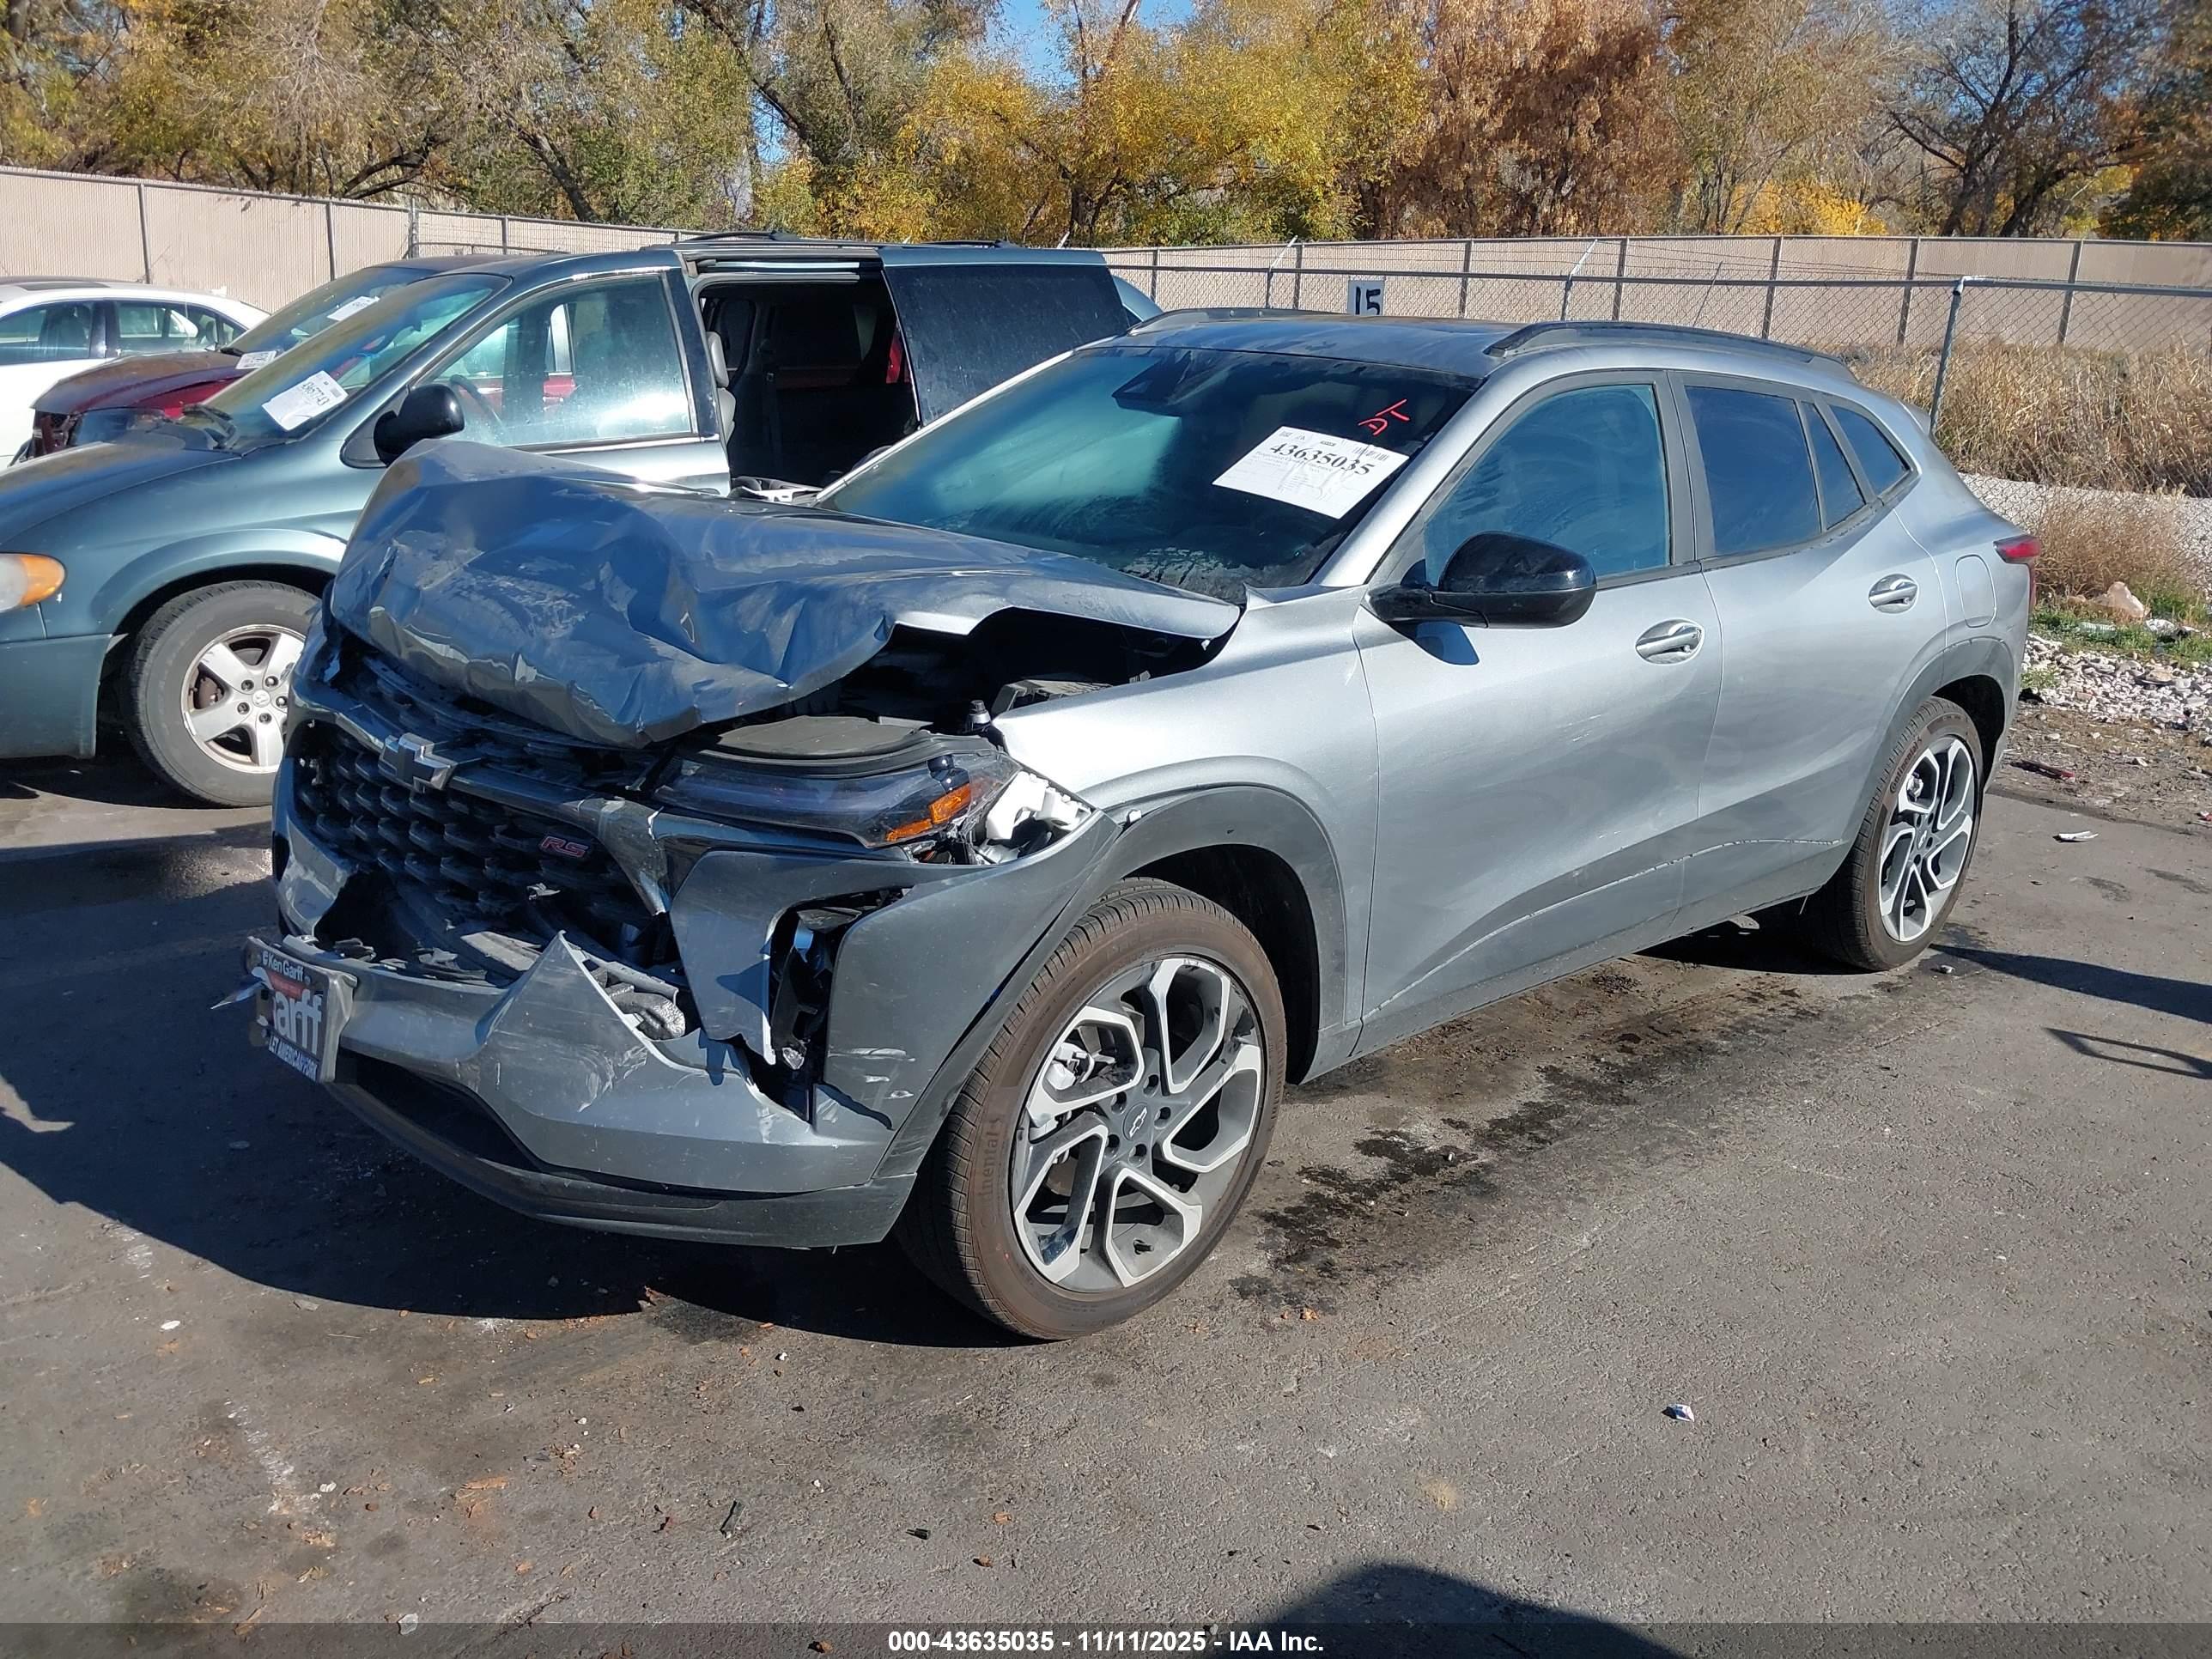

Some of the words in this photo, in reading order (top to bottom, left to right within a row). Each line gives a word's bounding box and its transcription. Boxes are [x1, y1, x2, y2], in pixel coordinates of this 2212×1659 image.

[1355, 286, 1381, 315] 15
[1270, 442, 1376, 475] 43635035
[541, 836, 589, 857] RS
